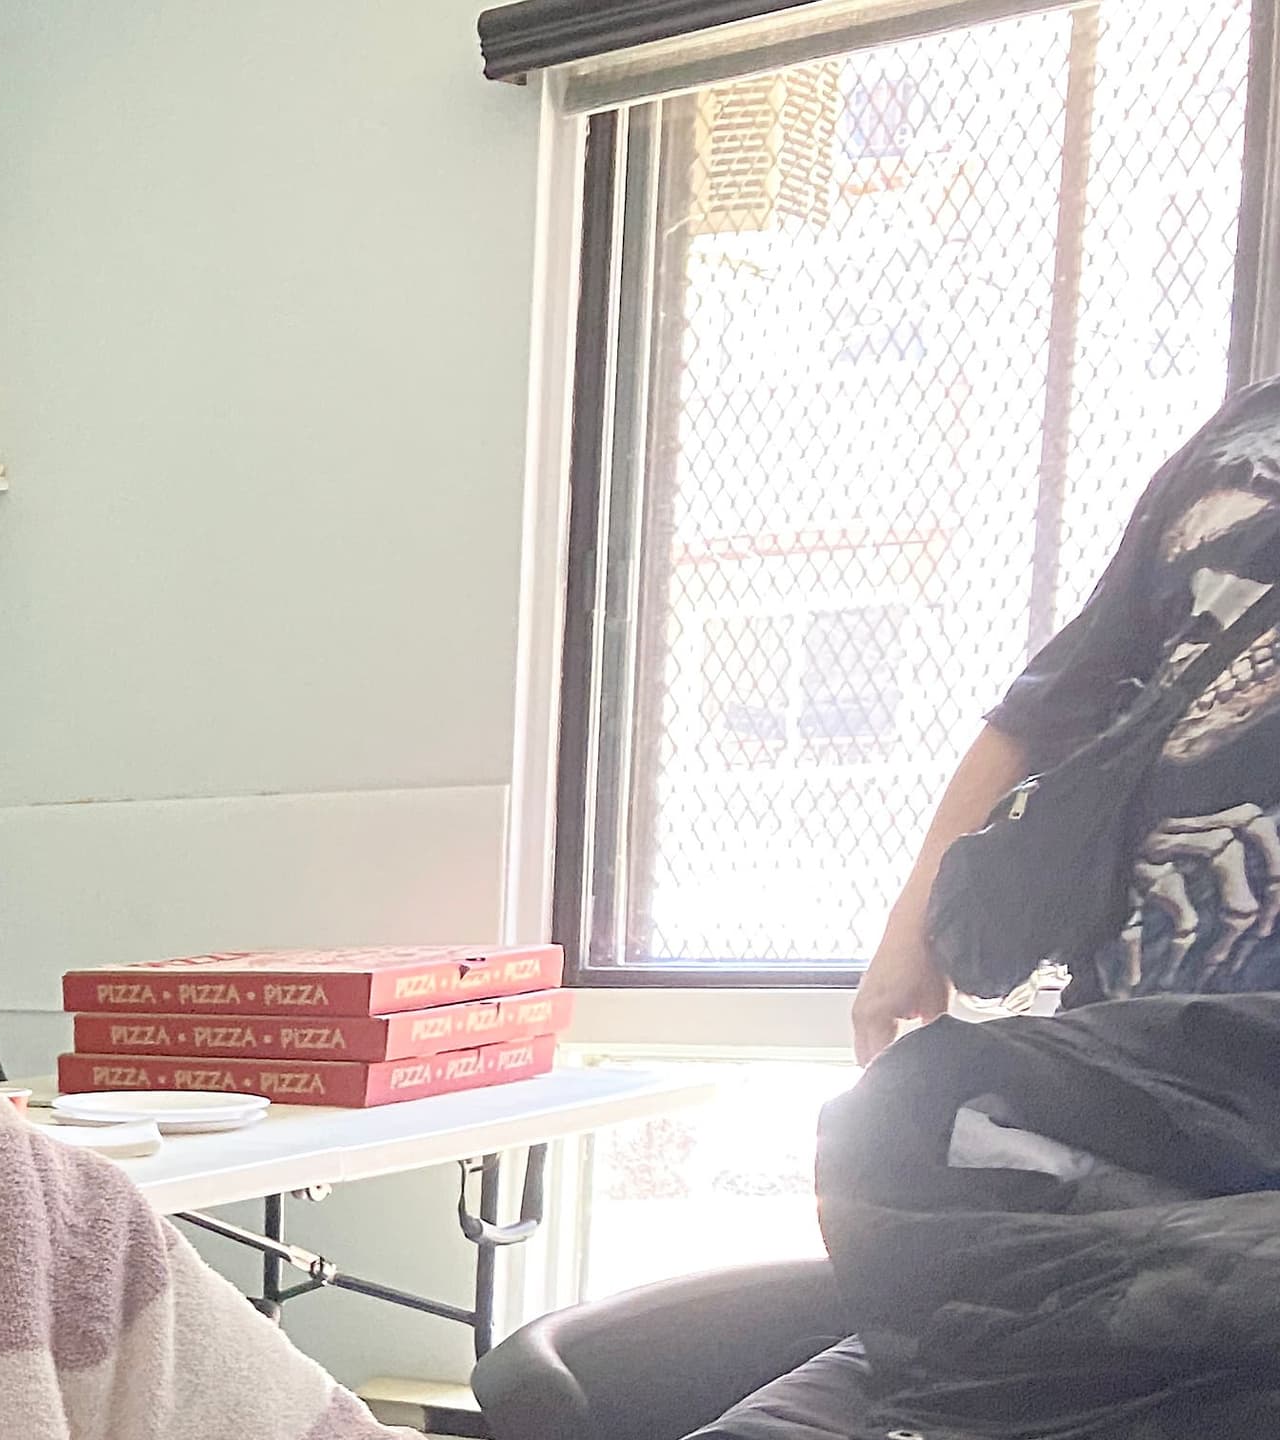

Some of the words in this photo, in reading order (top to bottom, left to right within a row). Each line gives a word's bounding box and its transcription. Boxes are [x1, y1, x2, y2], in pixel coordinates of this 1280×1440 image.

[96, 984, 156, 1004] PIZZA
[178, 984, 241, 1005] PIZZA
[262, 984, 329, 1006] PIZZA
[395, 975, 437, 999] PIZZA
[503, 959, 541, 982] PIZZA
[110, 1025, 170, 1046] PIZZA
[193, 1026, 257, 1048] PIZZA
[280, 1028, 346, 1050] PIZZA
[411, 1015, 452, 1042] PIZZA
[466, 1008, 505, 1033] PIZZA
[517, 1000, 553, 1025] PIZZA
[92, 1066, 151, 1088] PIZZA
[173, 1069, 237, 1091] PIZZA
[259, 1071, 326, 1095] PIZZA
[390, 1063, 432, 1090] PIZZA
[445, 1055, 486, 1080] PIZZA
[496, 1045, 534, 1072] PIZZA
